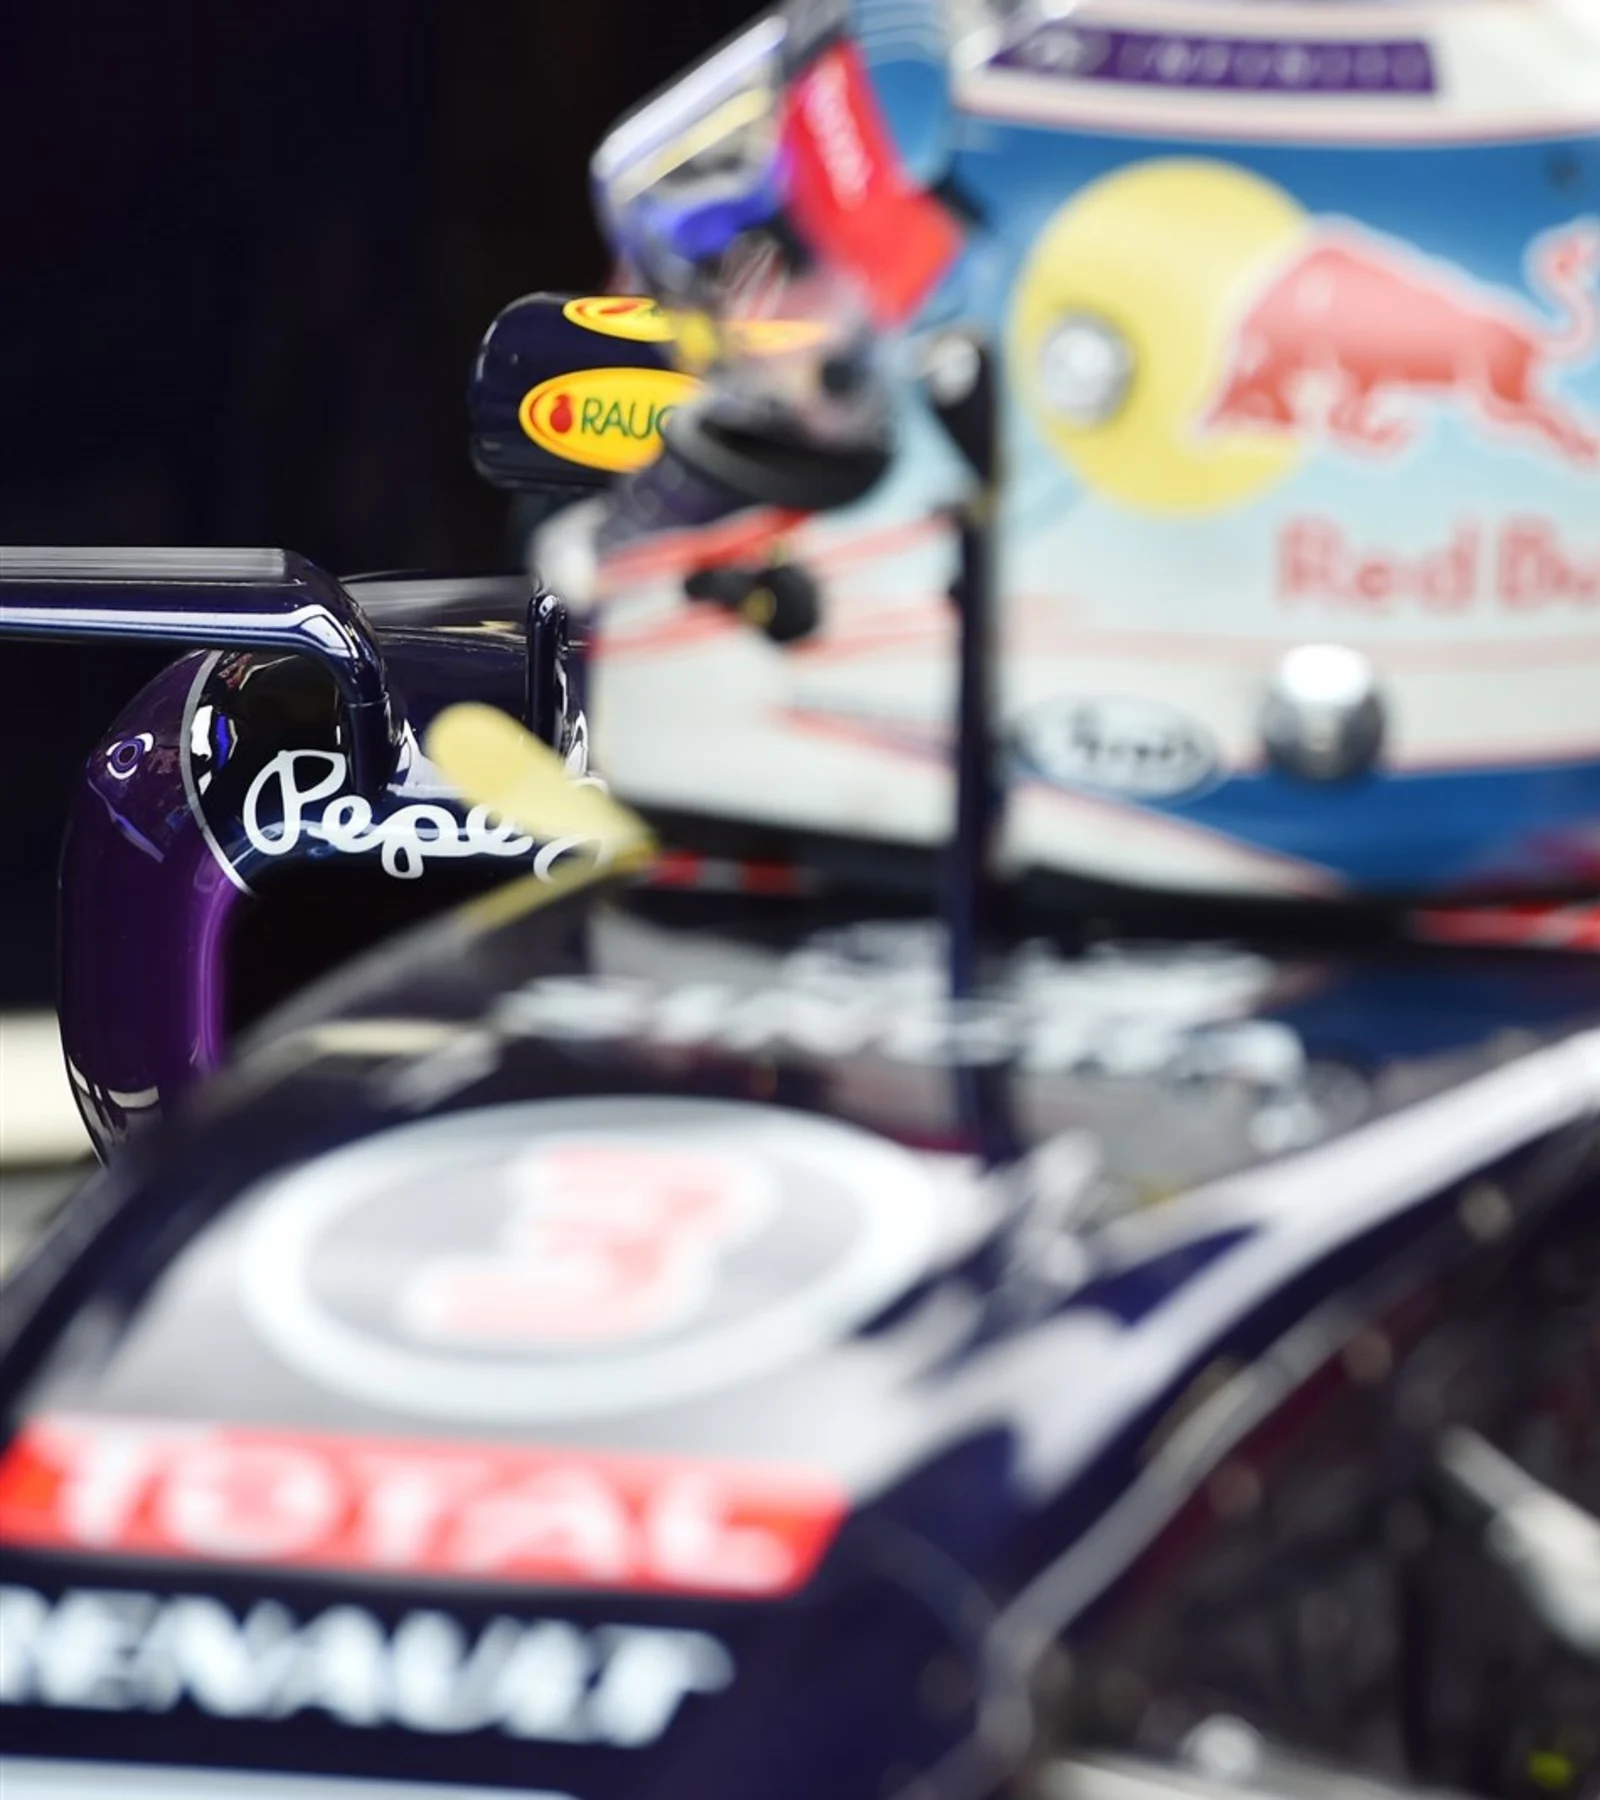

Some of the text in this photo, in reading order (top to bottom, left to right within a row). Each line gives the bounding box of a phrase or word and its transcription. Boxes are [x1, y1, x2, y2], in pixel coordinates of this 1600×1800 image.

[581, 396, 678, 440] RAUC
[1276, 515, 1478, 612] Red
[405, 1136, 775, 1342] 3
[45, 1425, 798, 1592] TOTAL
